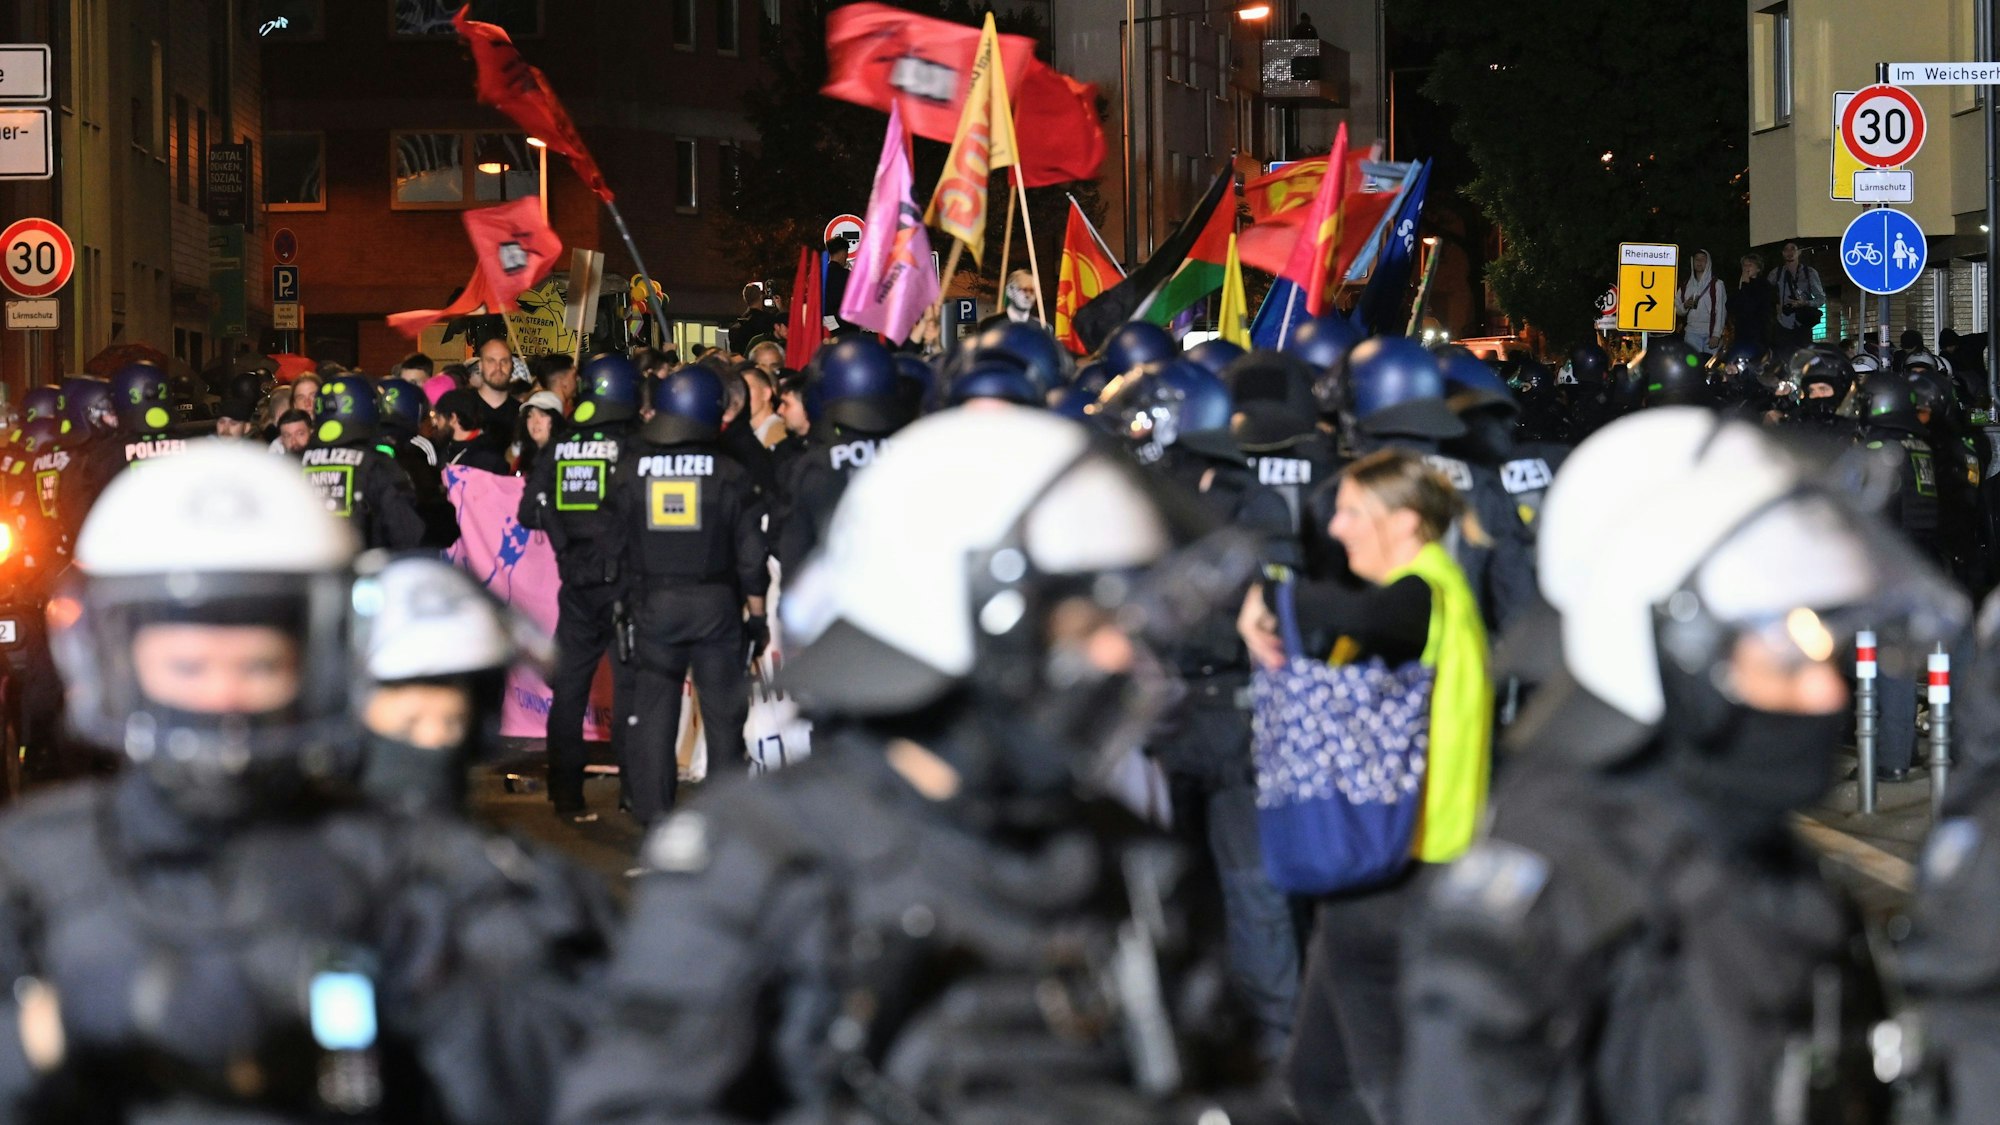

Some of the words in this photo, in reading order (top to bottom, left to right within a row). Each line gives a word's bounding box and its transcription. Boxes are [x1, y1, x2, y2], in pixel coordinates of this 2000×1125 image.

[1897, 67, 1914, 80] Im
[0, 126, 29, 140] er-
[1859, 108, 1906, 145] 30
[211, 151, 243, 161] DIGITAL
[210, 173, 242, 183] SOZIAL
[1859, 183, 1906, 191] Lärmschutz
[13, 241, 55, 275] 30
[1625, 249, 1672, 259] Rheinaustr.
[278, 270, 293, 298] P
[1641, 271, 1655, 289] U
[960, 300, 973, 320] P
[525, 316, 554, 327] STERBEN
[519, 327, 542, 335] NICHT
[341, 395, 354, 414] 2
[302, 447, 364, 466] POLIZEI
[565, 466, 595, 479] NRW
[637, 454, 714, 477] POLIZEI
[311, 471, 342, 485] NRW
